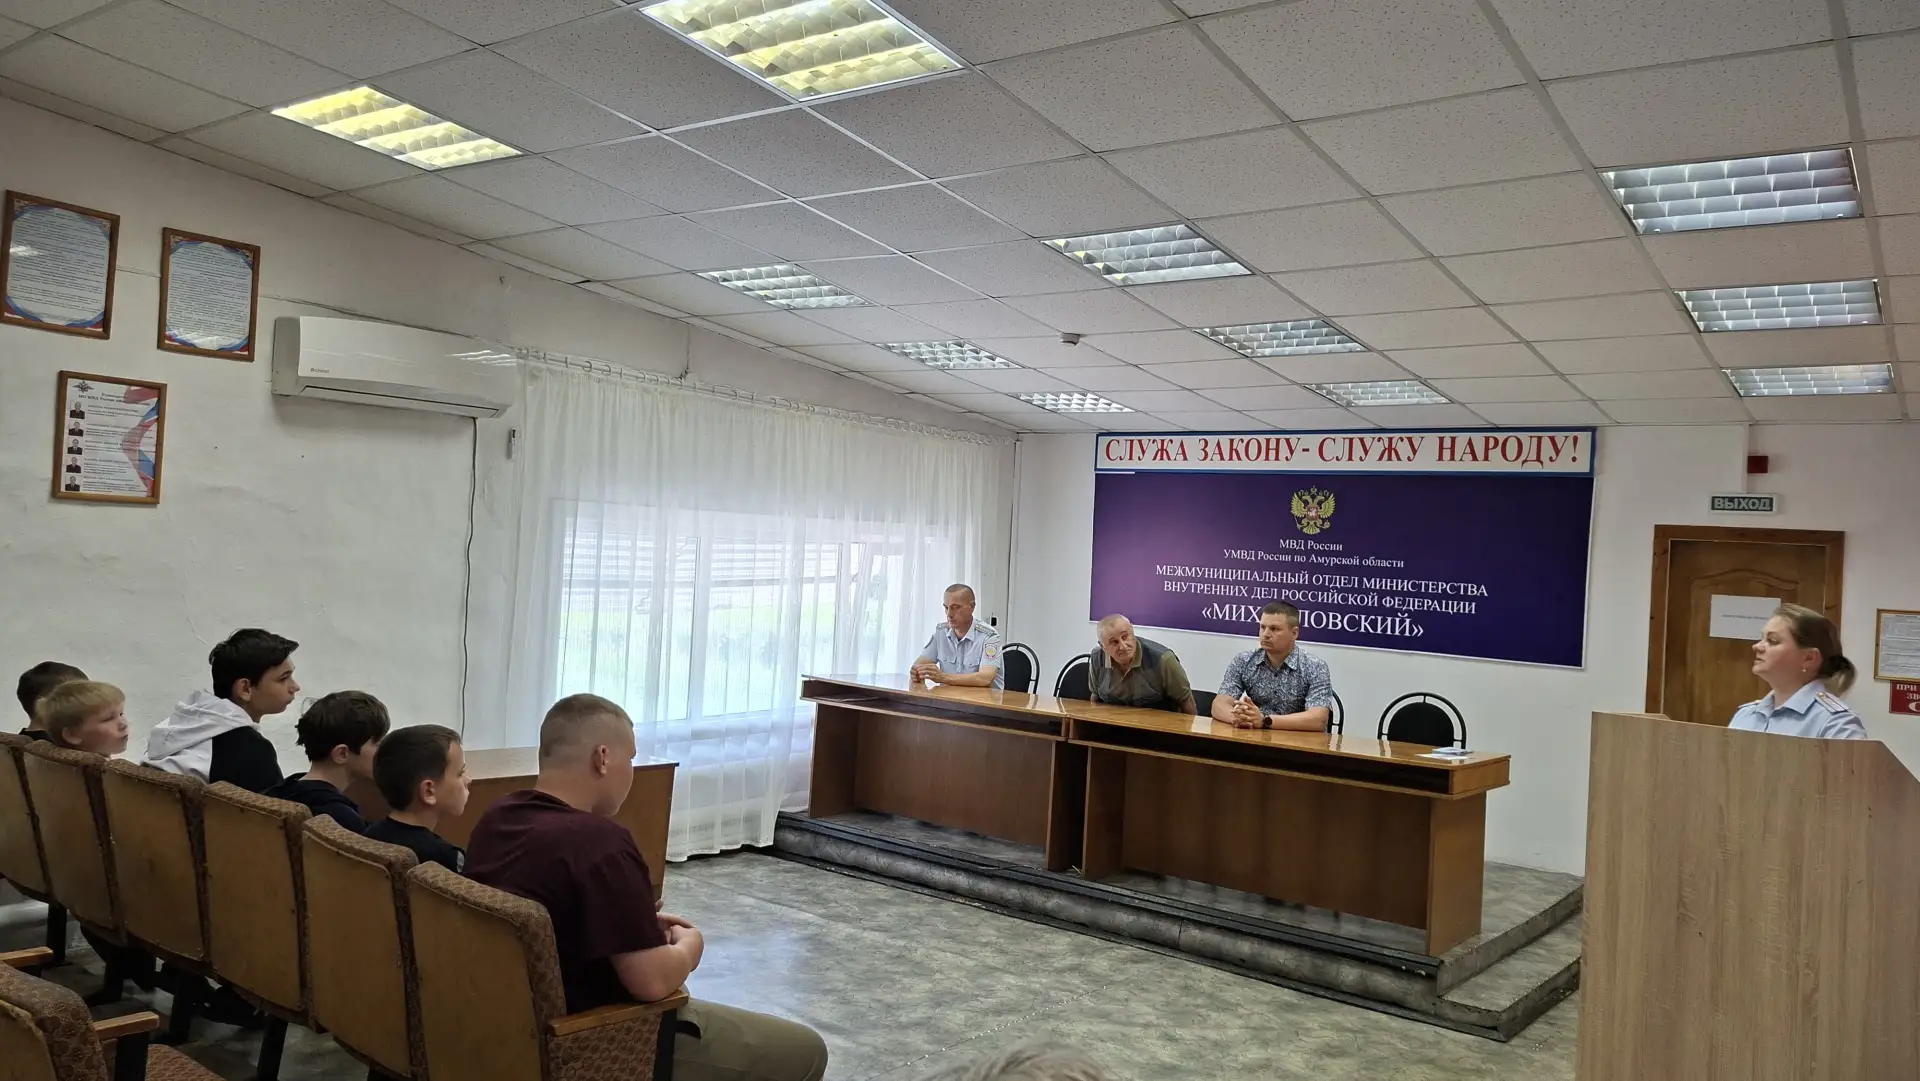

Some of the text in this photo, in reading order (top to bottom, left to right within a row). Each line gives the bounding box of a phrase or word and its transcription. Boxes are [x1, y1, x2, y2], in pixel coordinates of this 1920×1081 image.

[1105, 438, 1190, 462] СЛУЖА
[1317, 436, 1424, 463] СЛУЖУ
[1436, 434, 1580, 470] НАРОДУ!
[1714, 497, 1770, 511] ВЫХОД
[1223, 549, 1404, 568] УМВД России по Амурской области
[1279, 538, 1343, 552] МВД России
[1156, 564, 1489, 597] МЕЖМУНИЦИПАЛЬНЫЙ ОТДЕЛ МИНИСТЕРСТВА
[1164, 580, 1477, 615] ВНУТРЕННИХ ДЕЛ РОССИЙСКОЙ ФЕДЕРАЦИИ
[1201, 602, 1424, 638] «МИХЛОВСКИЙ»
